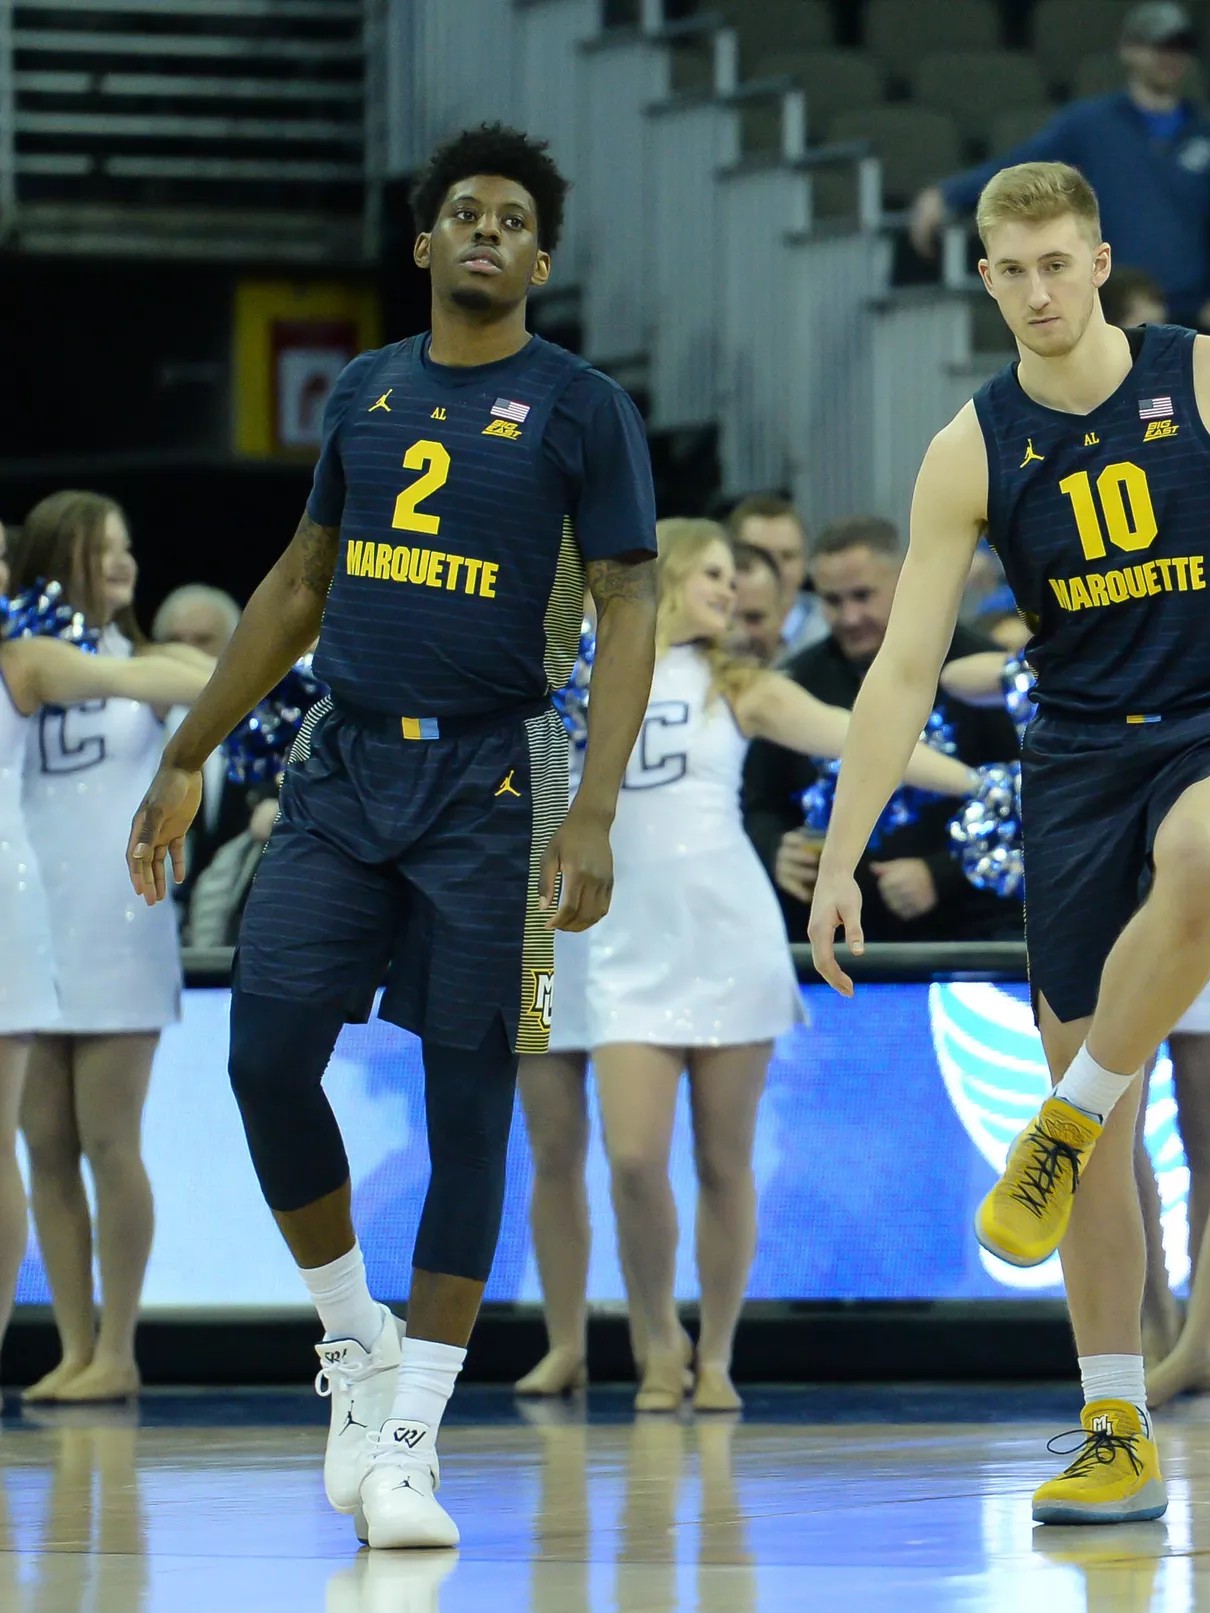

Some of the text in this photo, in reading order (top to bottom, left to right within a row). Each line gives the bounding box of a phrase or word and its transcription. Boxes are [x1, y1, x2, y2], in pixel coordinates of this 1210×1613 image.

[431, 407, 447, 420] AL
[1084, 432, 1099, 446] AL
[1144, 425, 1179, 438] EAST
[1147, 419, 1172, 430] BIG
[392, 440, 451, 535] 2
[1059, 461, 1158, 560] 10
[346, 540, 499, 598] MARQUETTE
[1048, 556, 1206, 612] MARQUETTE
[620, 700, 689, 790] C
